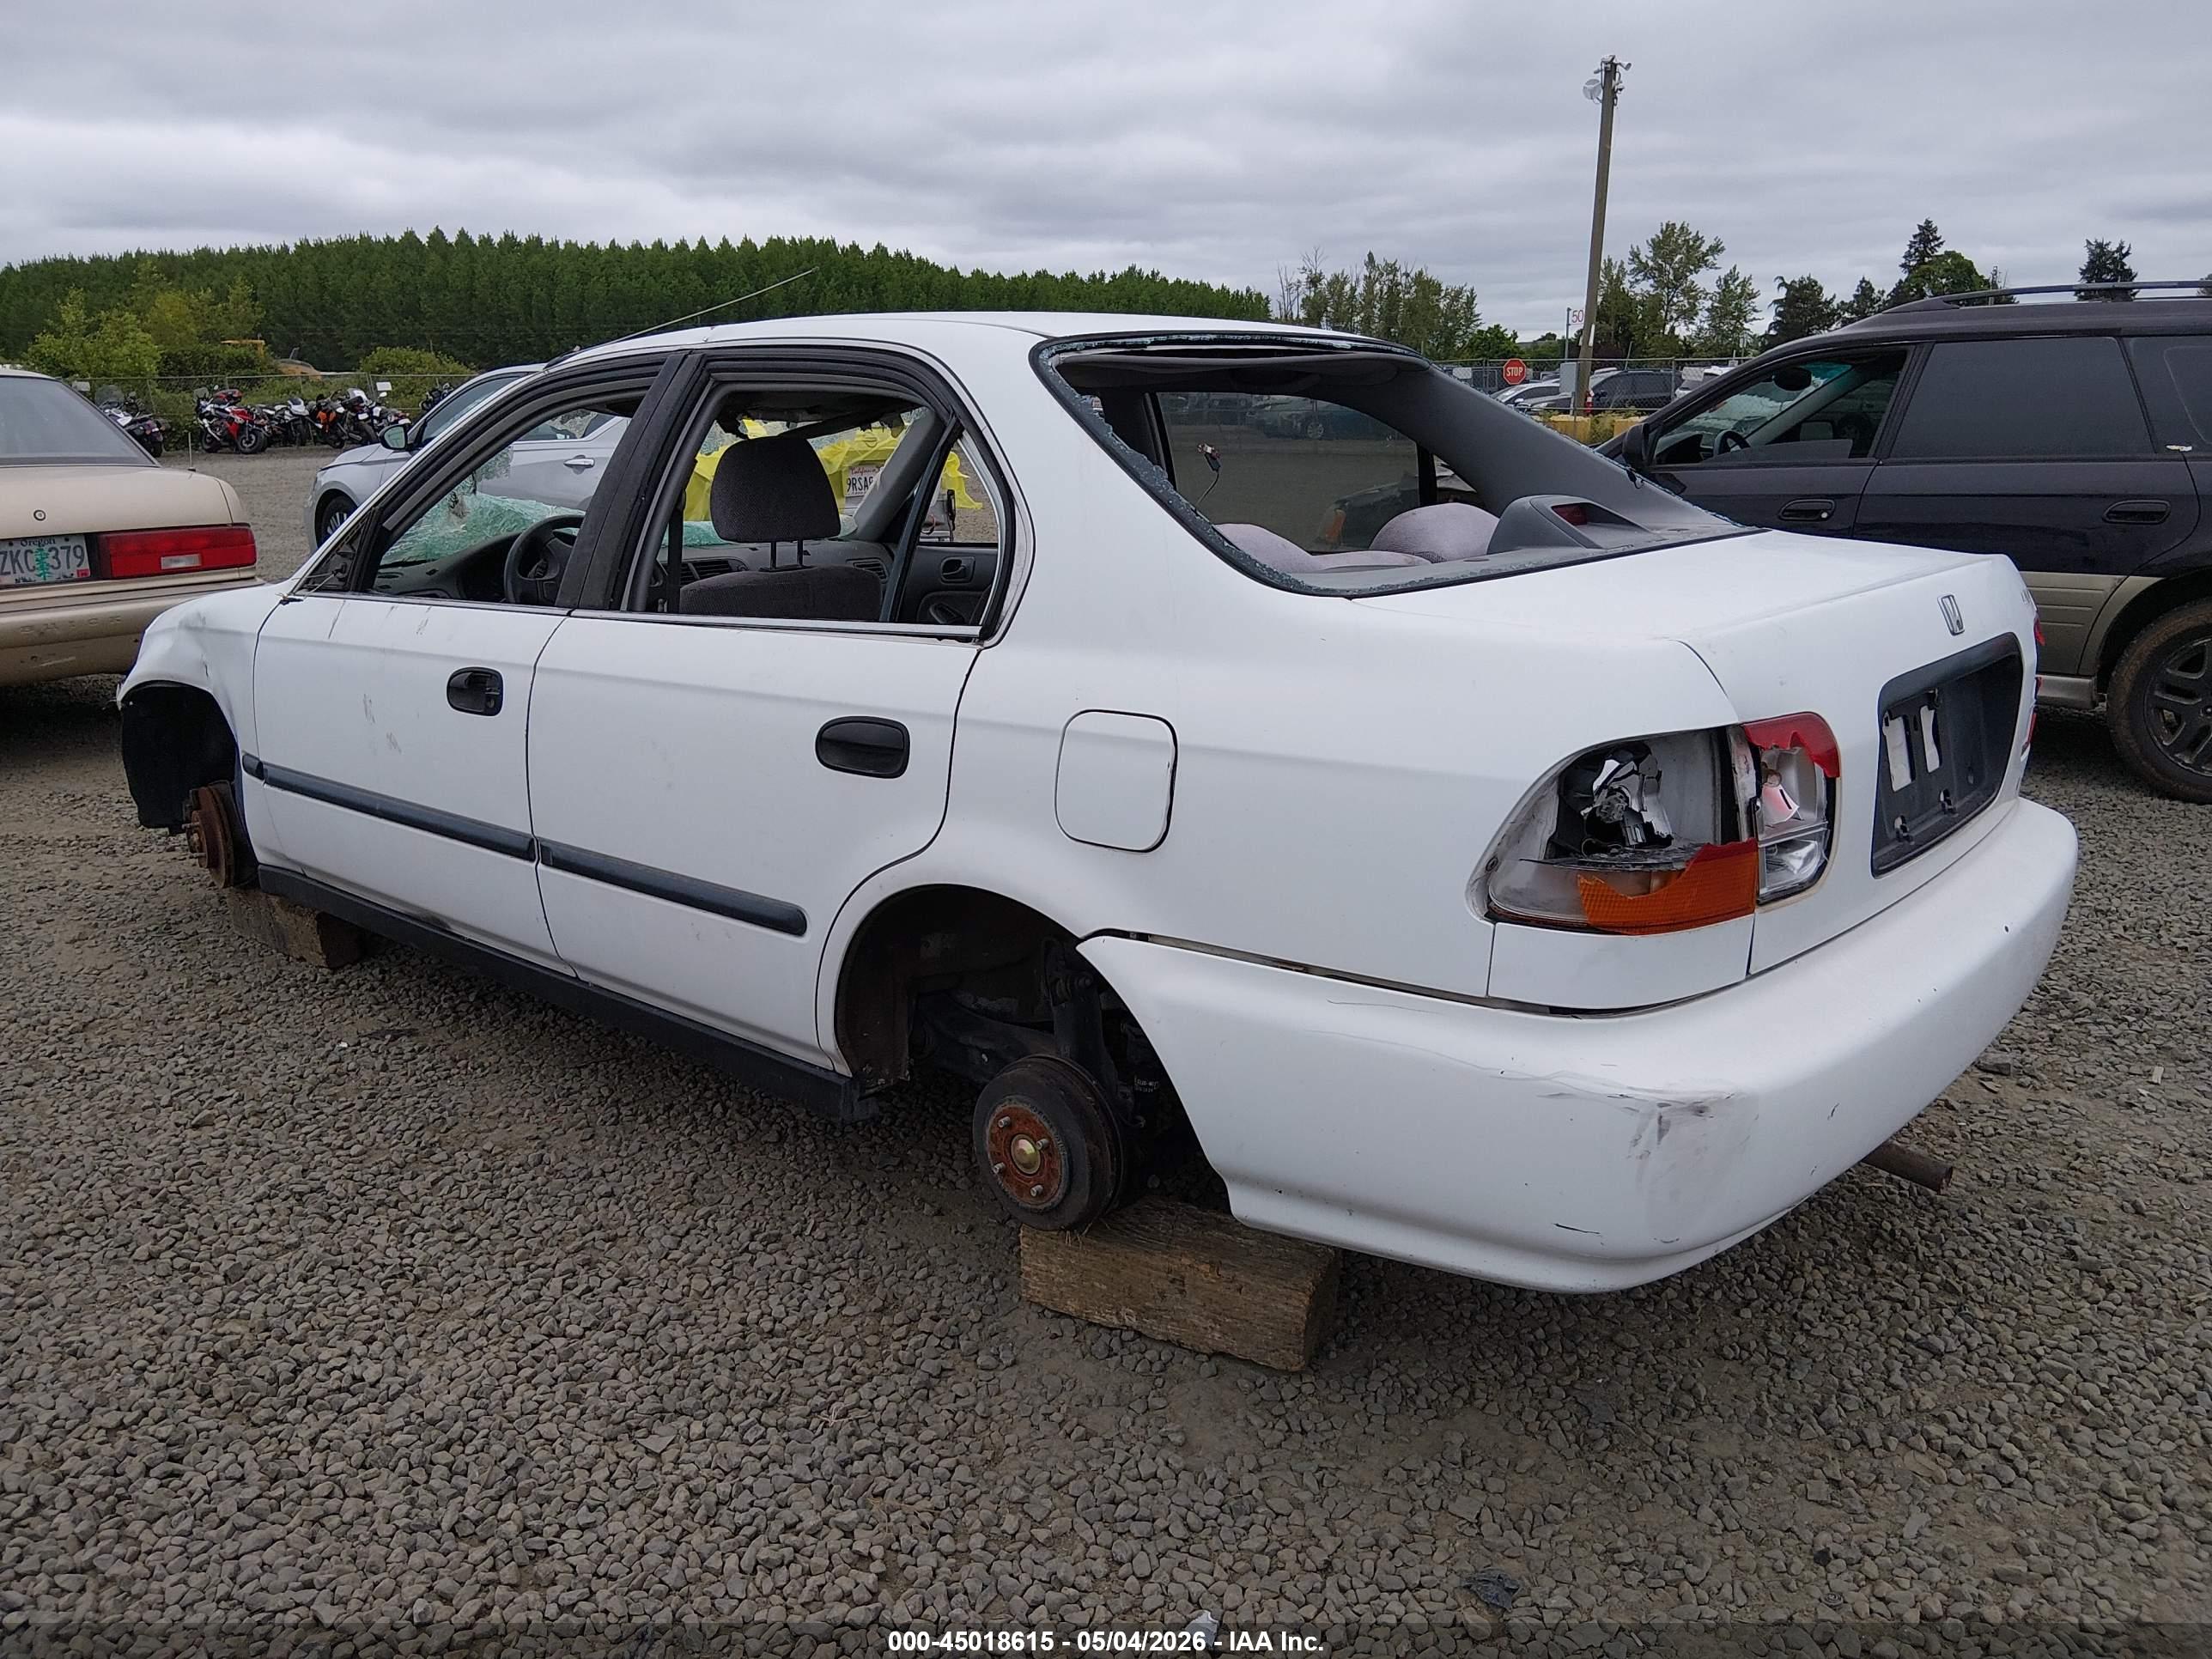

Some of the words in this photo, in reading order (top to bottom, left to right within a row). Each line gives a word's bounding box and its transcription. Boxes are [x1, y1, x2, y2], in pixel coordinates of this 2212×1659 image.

[1571, 309, 1584, 323] 50
[1506, 367, 1523, 377] STOP
[20, 538, 56, 547] Oregon
[0, 549, 35, 575] ZKC
[48, 544, 85, 569] 379
